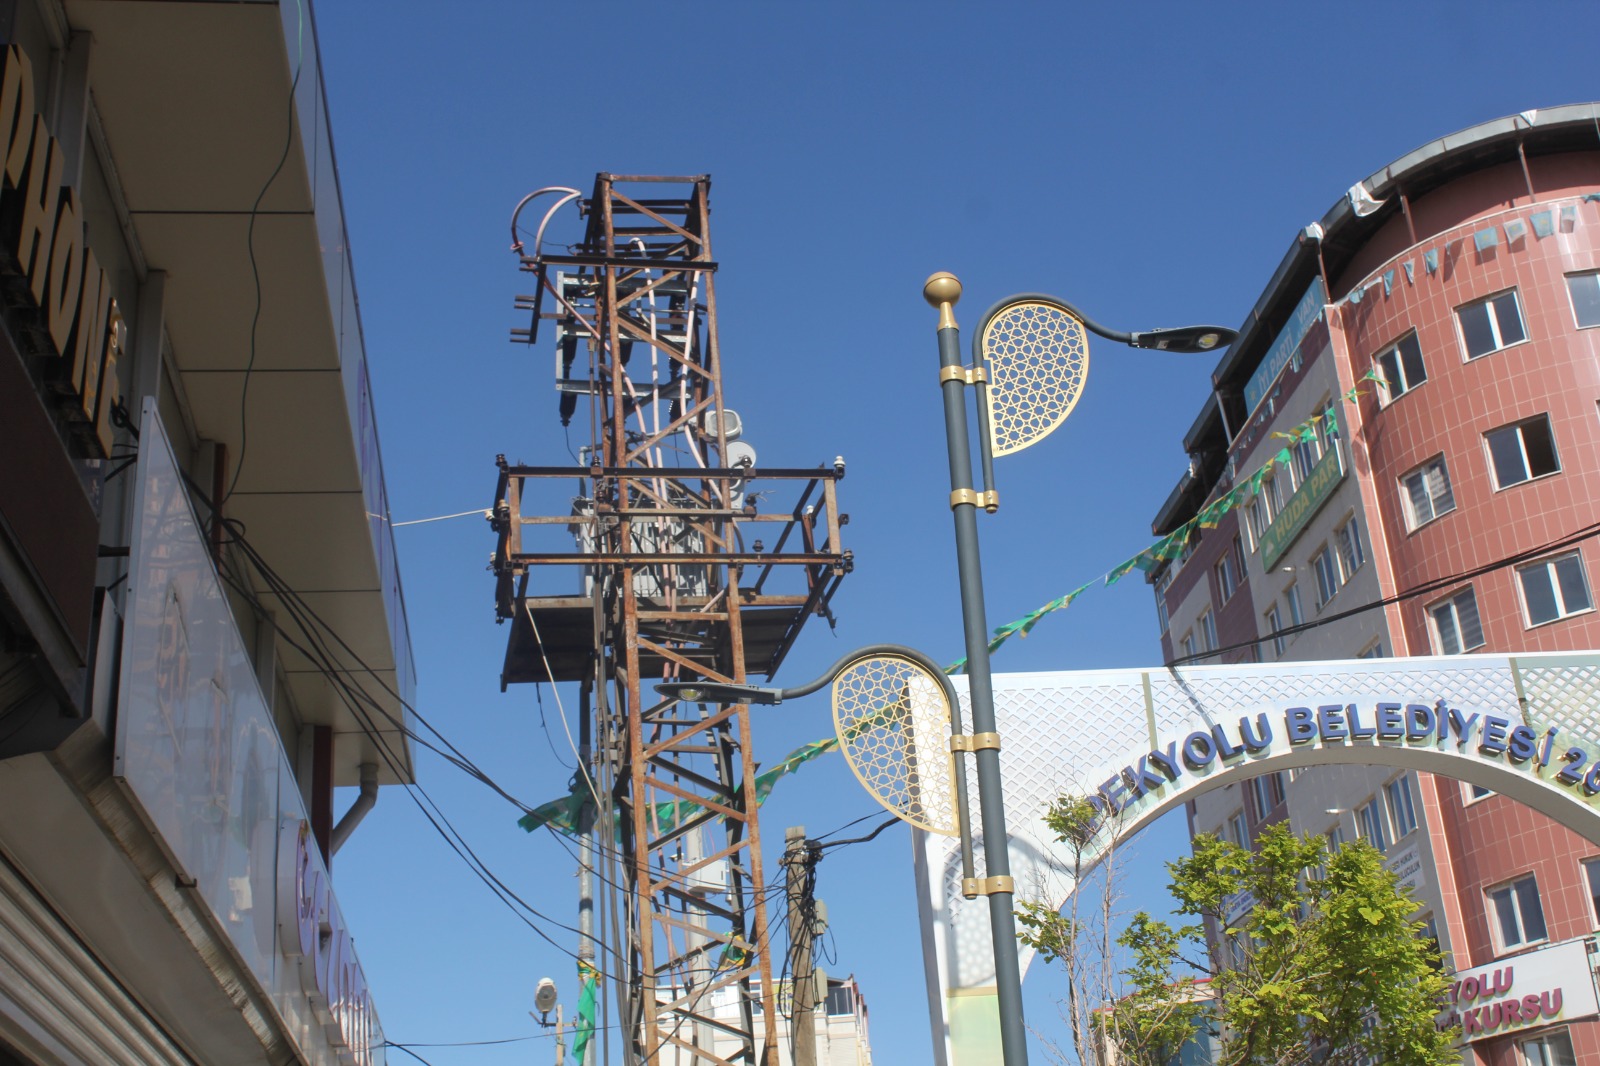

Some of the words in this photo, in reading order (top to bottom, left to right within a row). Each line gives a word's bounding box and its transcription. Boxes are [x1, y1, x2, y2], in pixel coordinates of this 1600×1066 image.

[1297, 290, 1316, 326] VAN
[1310, 453, 1338, 498] PAR
[1284, 698, 1559, 769] BELEDİYESİ
[1463, 987, 1563, 1035] KURSU
